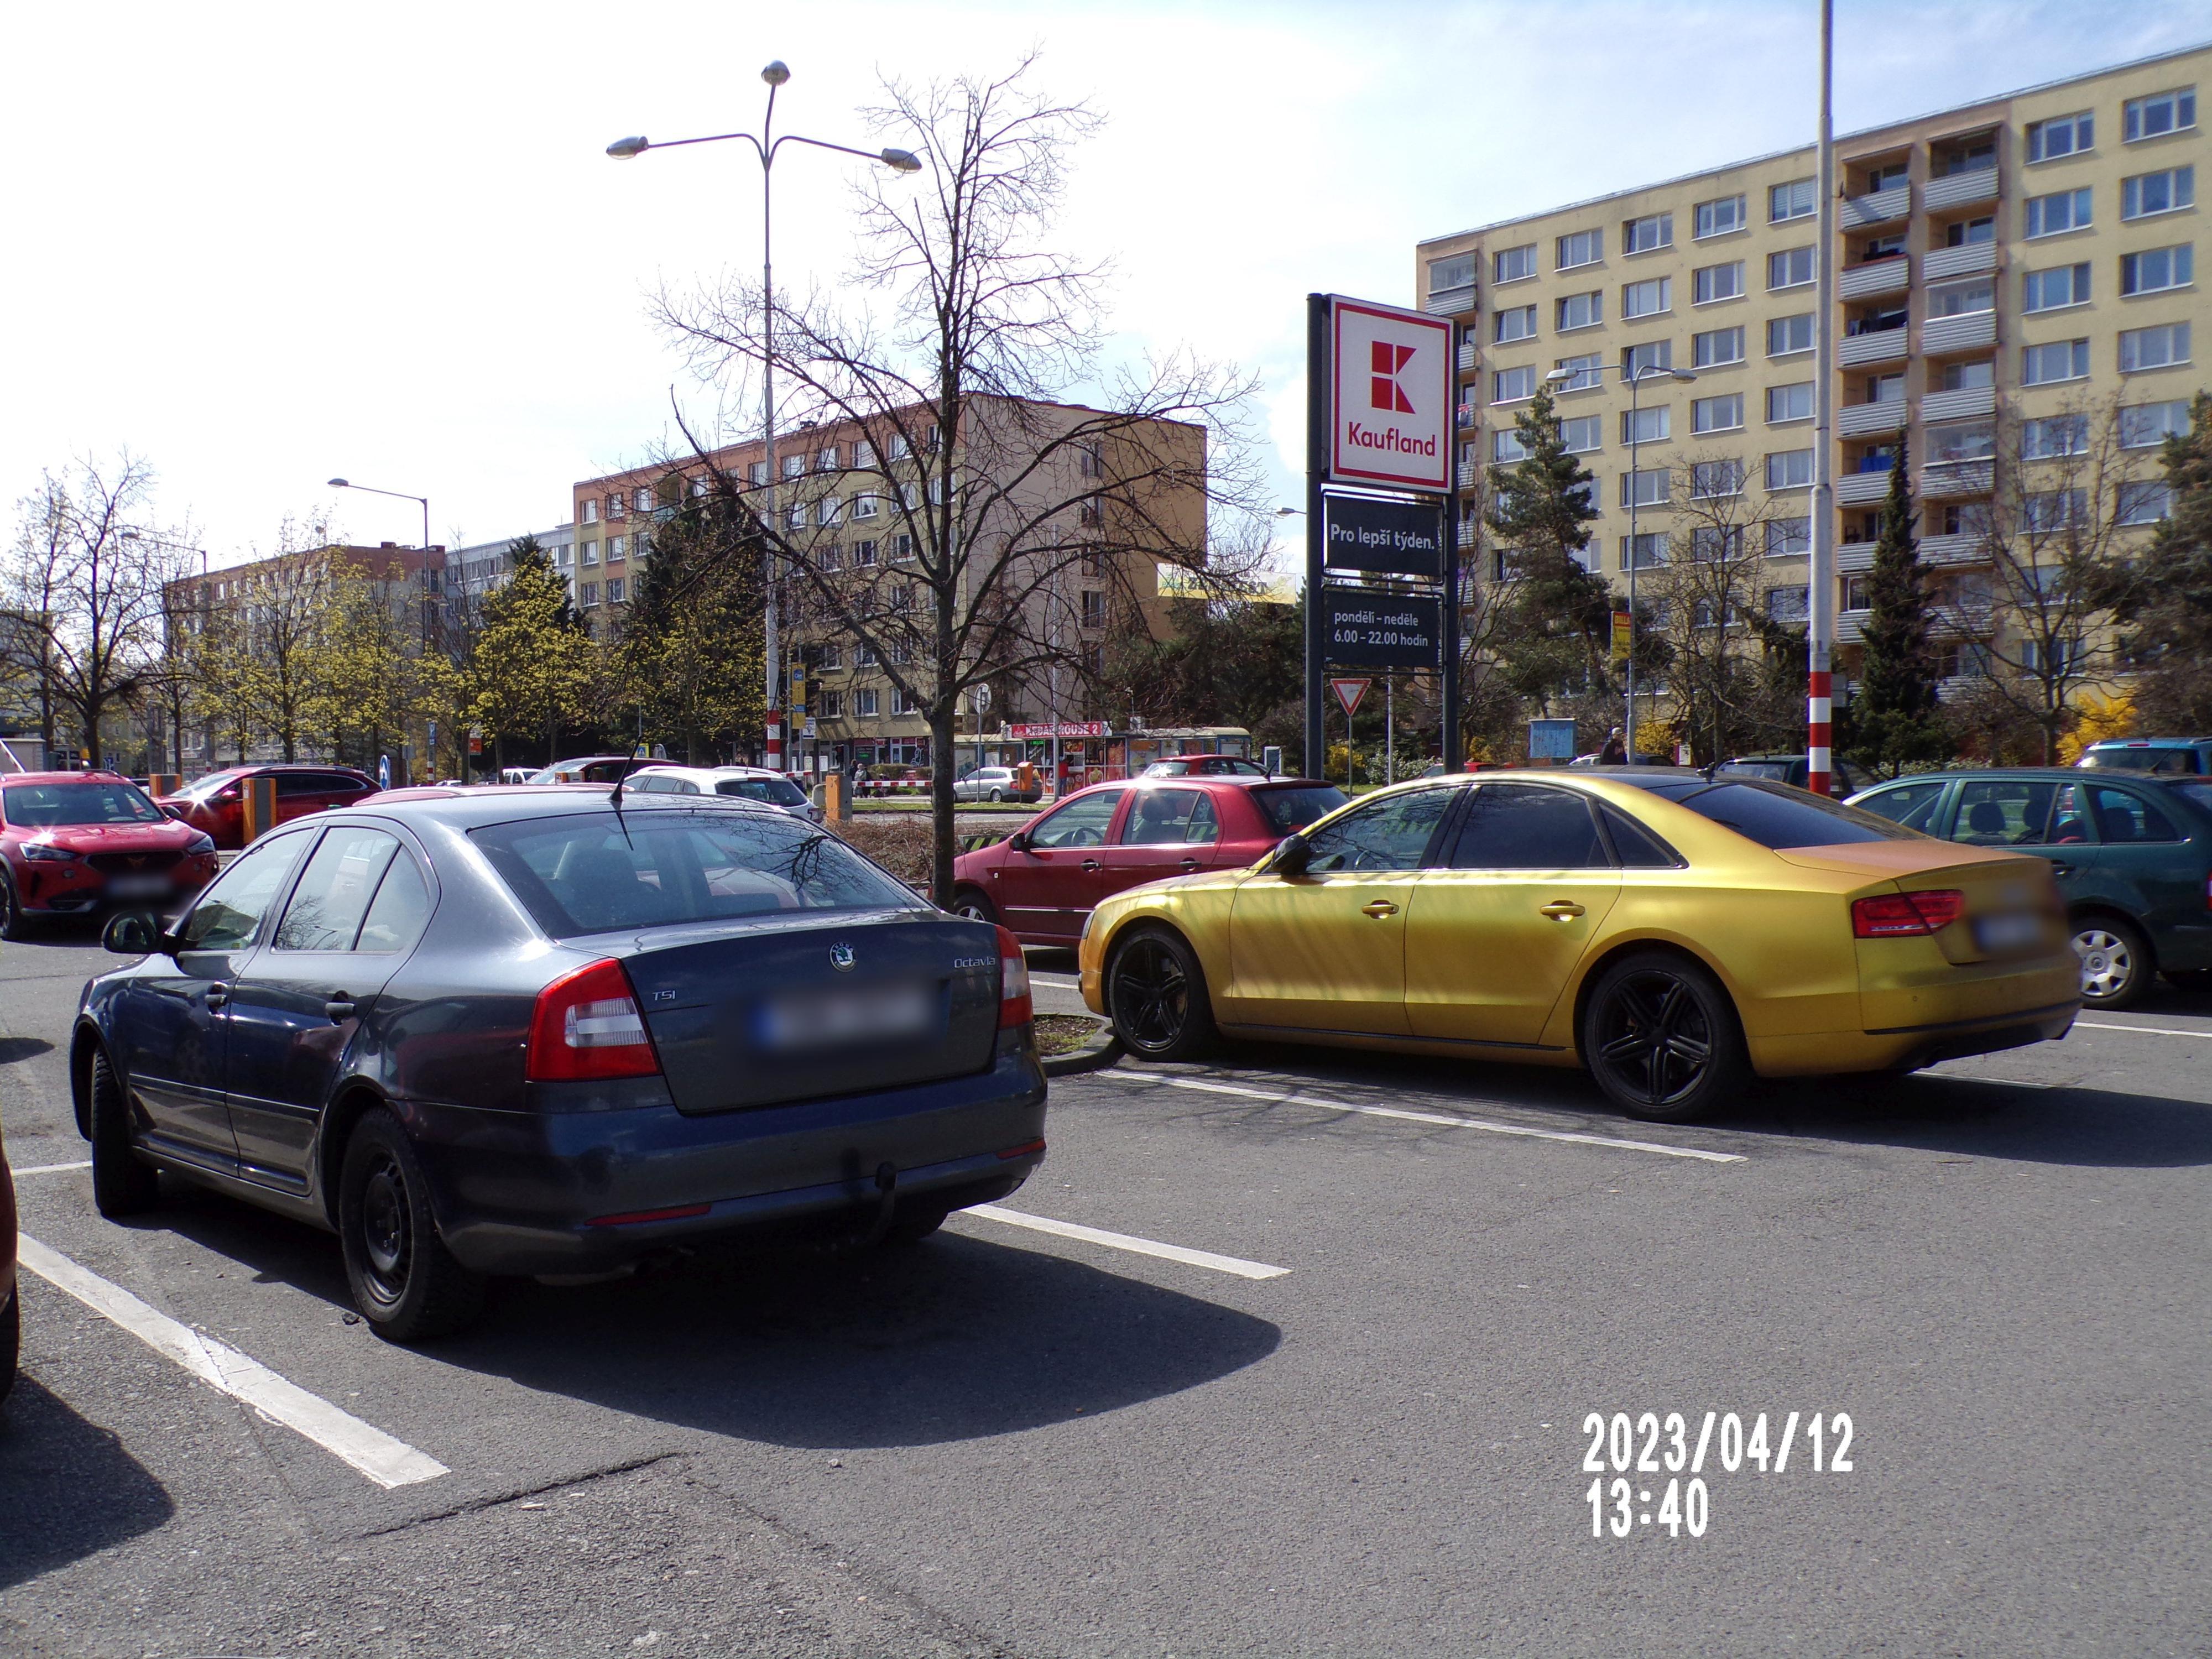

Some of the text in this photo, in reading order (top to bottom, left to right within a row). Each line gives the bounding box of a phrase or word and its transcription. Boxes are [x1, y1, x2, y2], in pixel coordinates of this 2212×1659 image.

[1348, 421, 1436, 457] Kaufland
[1331, 524, 1435, 551] Pro lepší týden.
[1334, 610, 1375, 625] pondělí
[1384, 612, 1419, 626] neděle
[1334, 629, 1358, 643] 6.00
[1368, 630, 1397, 645] 22.00
[1400, 633, 1428, 646] hodin
[1092, 724, 1098, 734] 2
[954, 956, 995, 968] Octavia
[652, 990, 675, 1001] TSI
